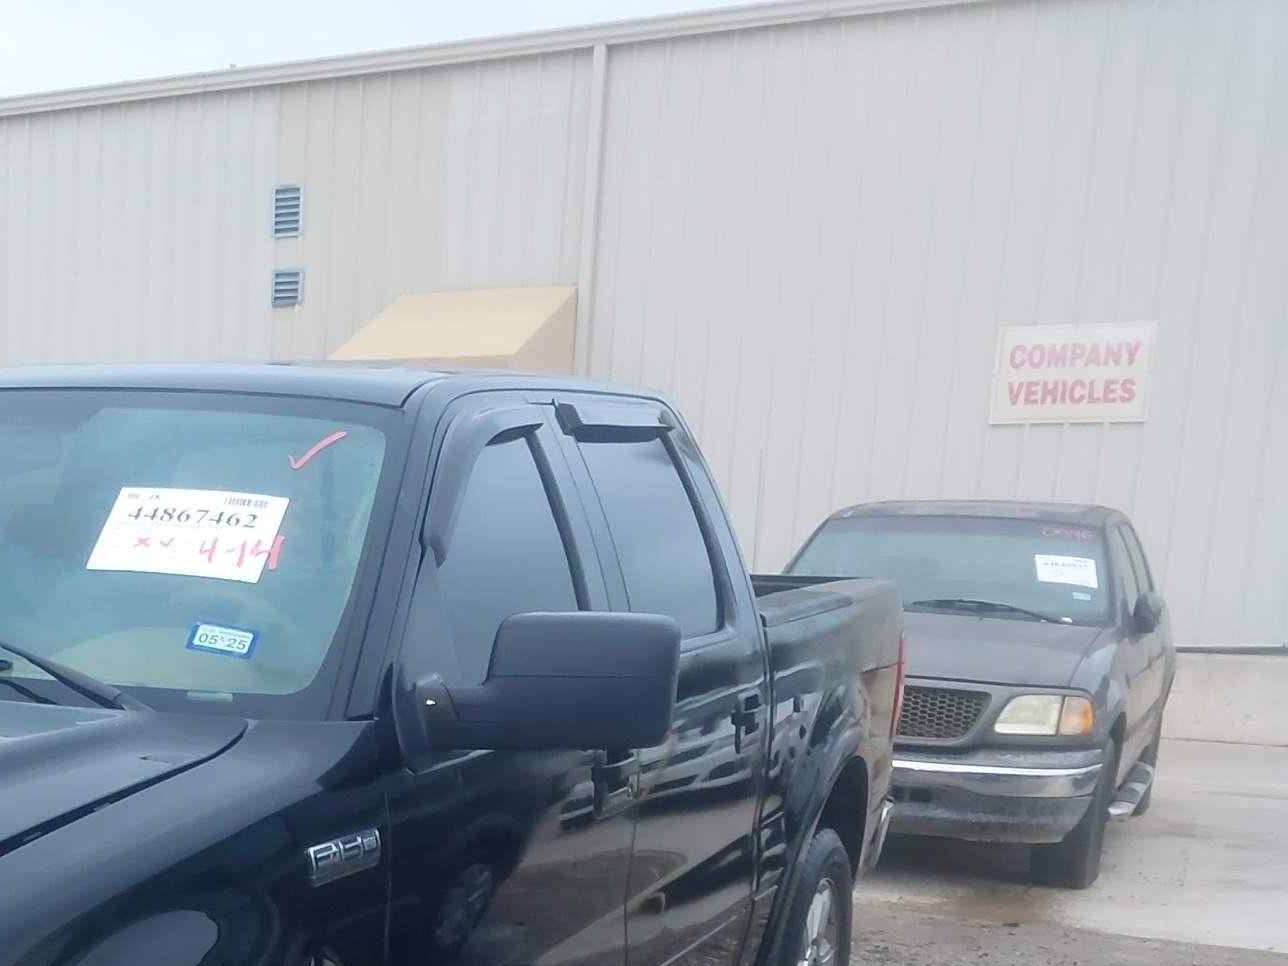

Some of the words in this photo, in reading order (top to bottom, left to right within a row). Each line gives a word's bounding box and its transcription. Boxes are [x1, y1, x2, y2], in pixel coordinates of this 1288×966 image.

[1008, 340, 1143, 370] COMPANY
[1006, 377, 1137, 406] VEHICLES
[127, 505, 259, 529] 44867462
[198, 632, 220, 645] 05
[225, 638, 249, 651] 25
